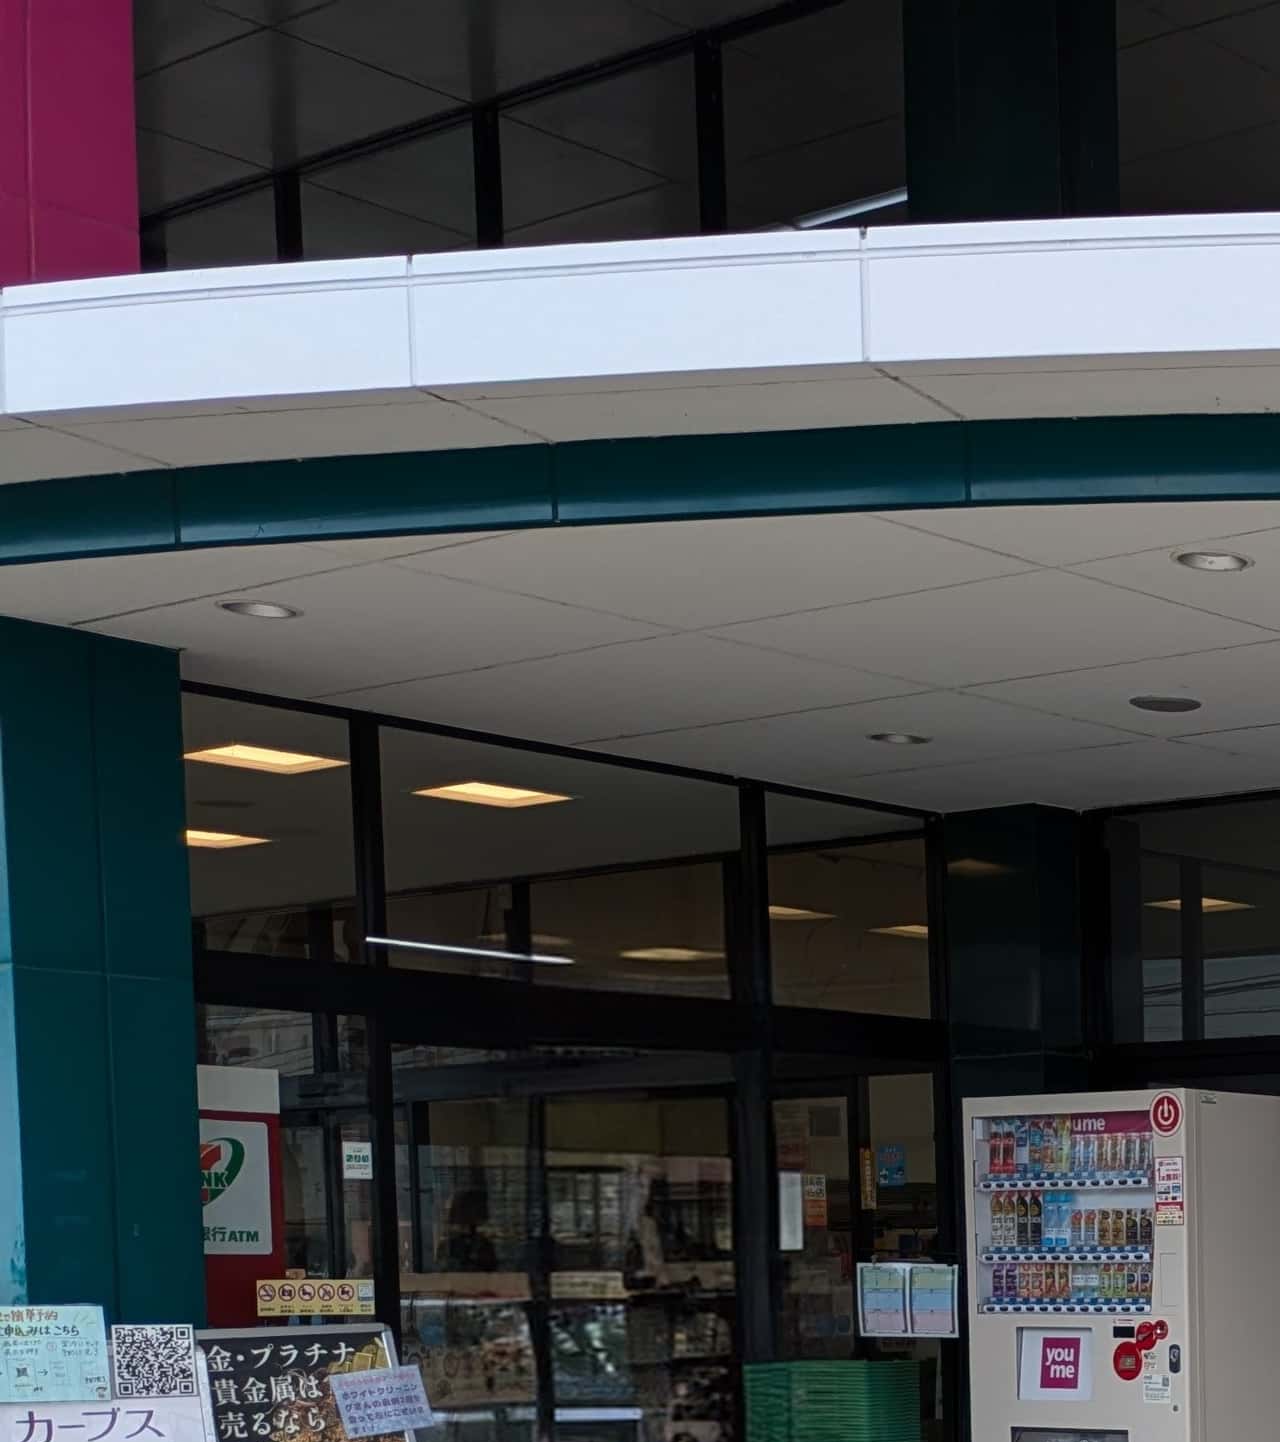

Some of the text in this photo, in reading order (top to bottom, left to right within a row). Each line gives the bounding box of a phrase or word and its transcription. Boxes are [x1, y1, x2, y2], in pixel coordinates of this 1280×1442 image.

[206, 1341, 356, 1373] 金・プラチナ
[1045, 1347, 1074, 1365] you
[1050, 1366, 1075, 1378] me
[212, 1375, 324, 1406] 貴金属は
[218, 1407, 326, 1439] 売るなら
